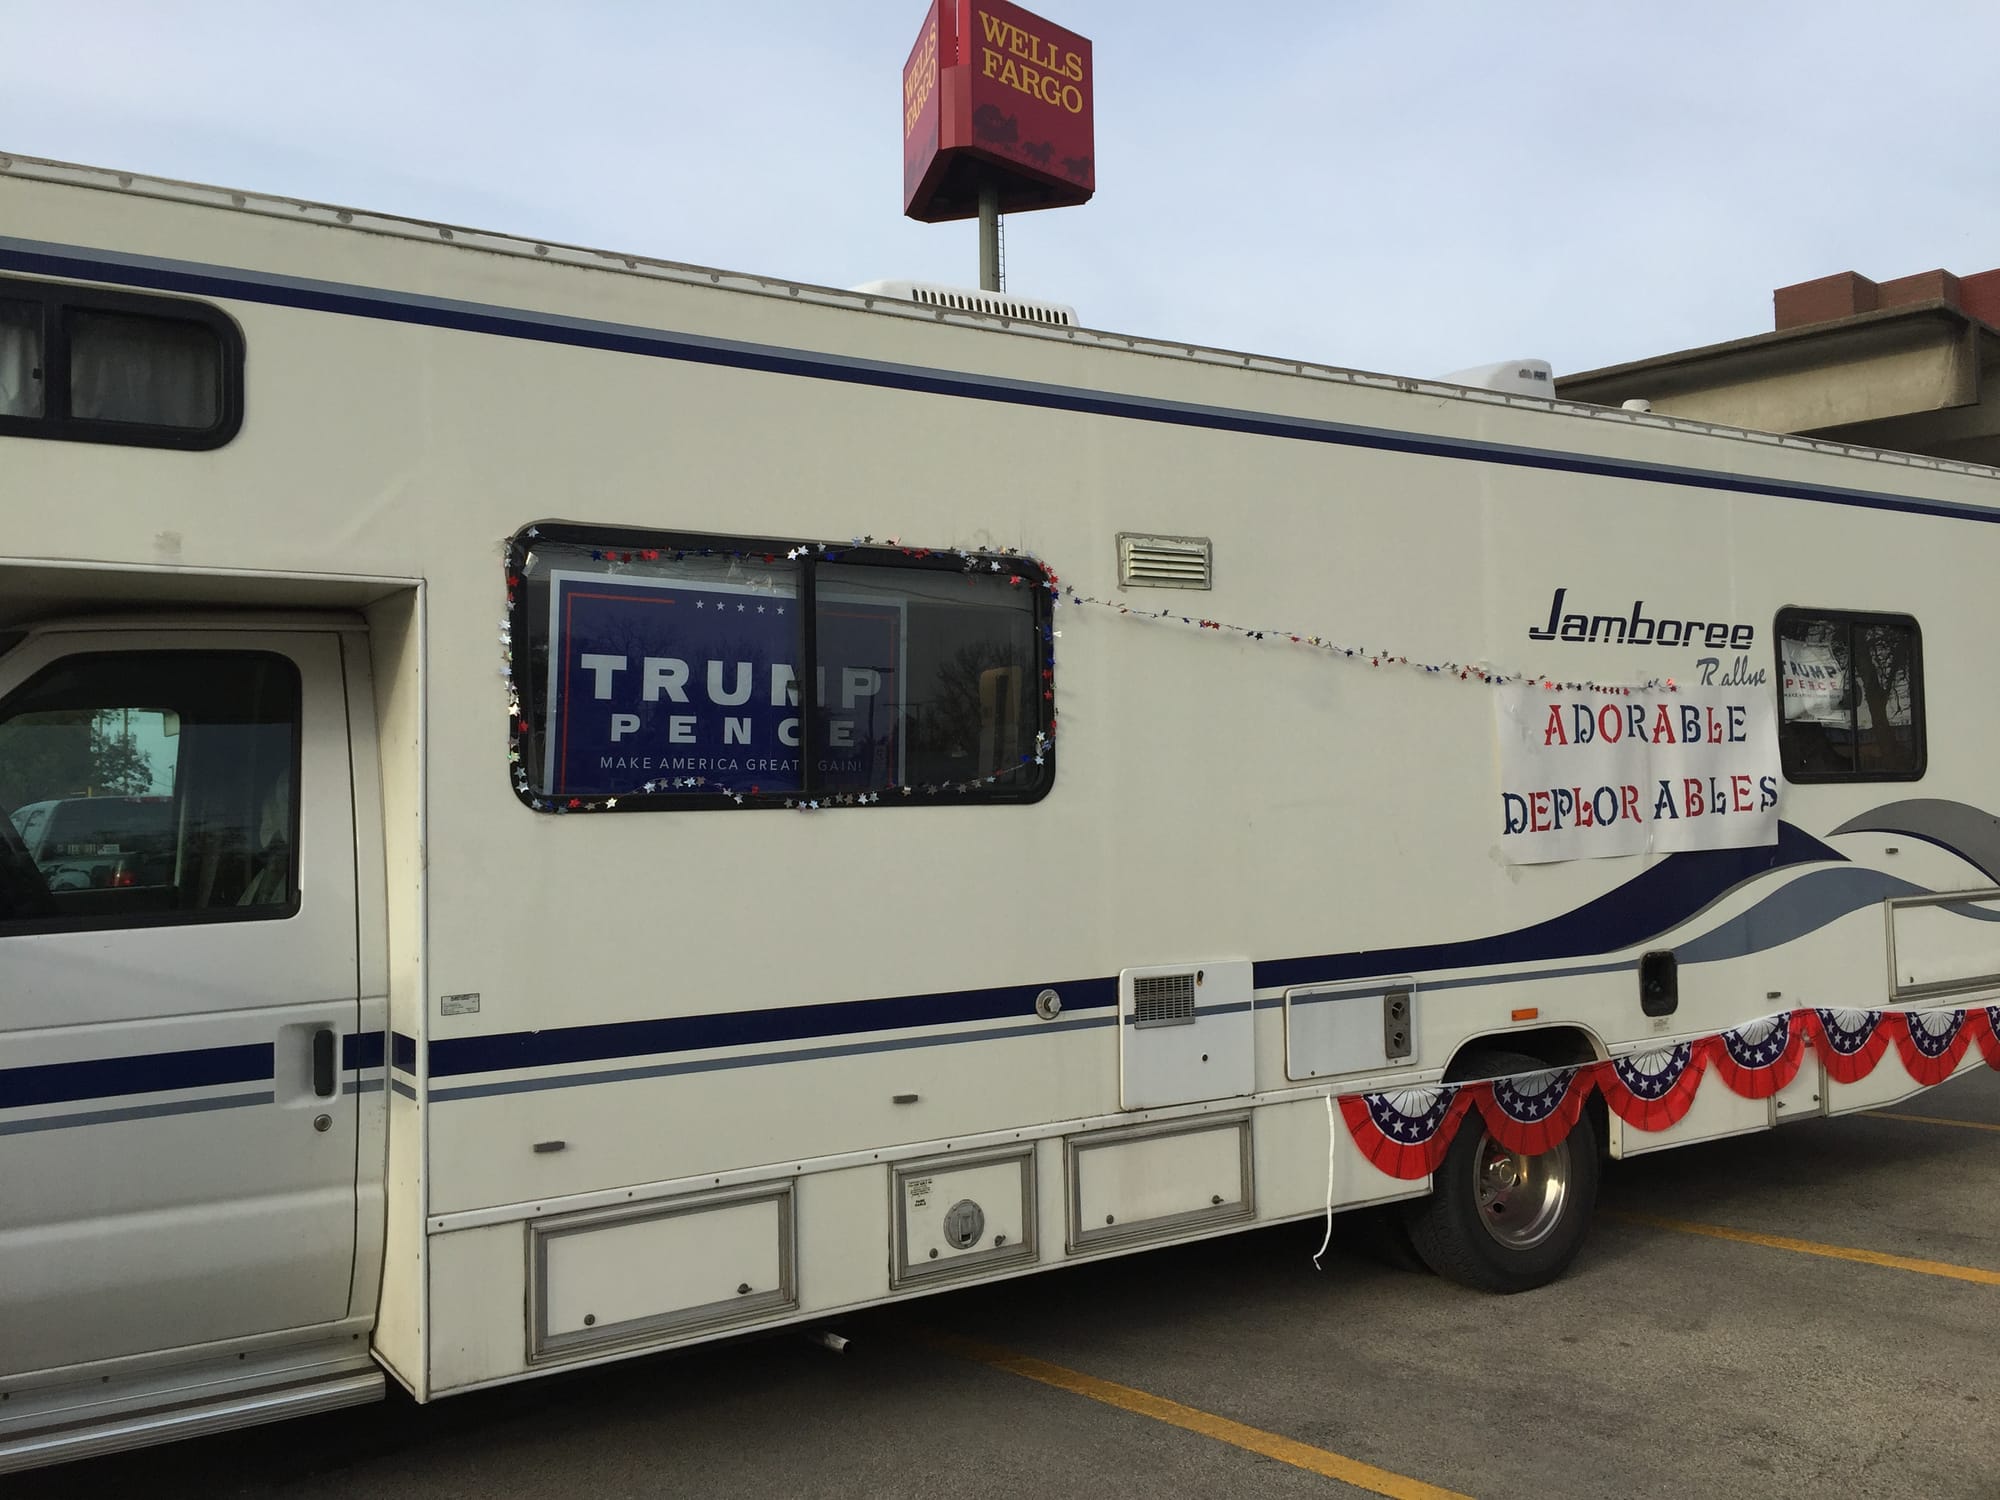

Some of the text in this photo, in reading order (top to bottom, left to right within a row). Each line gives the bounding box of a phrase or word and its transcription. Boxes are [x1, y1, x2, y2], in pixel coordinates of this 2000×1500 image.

[905, 22, 936, 104] WELLS
[978, 10, 1084, 82] WELLS
[906, 58, 936, 139] FARGO
[982, 47, 1083, 113] FARGO
[1529, 588, 1754, 650] Jamboree
[580, 653, 882, 710] TRUMP
[611, 713, 855, 748] PENCE
[1544, 704, 1747, 746] ADORABLE
[600, 756, 862, 772] MAKE AMERICA GREAT GAIN!
